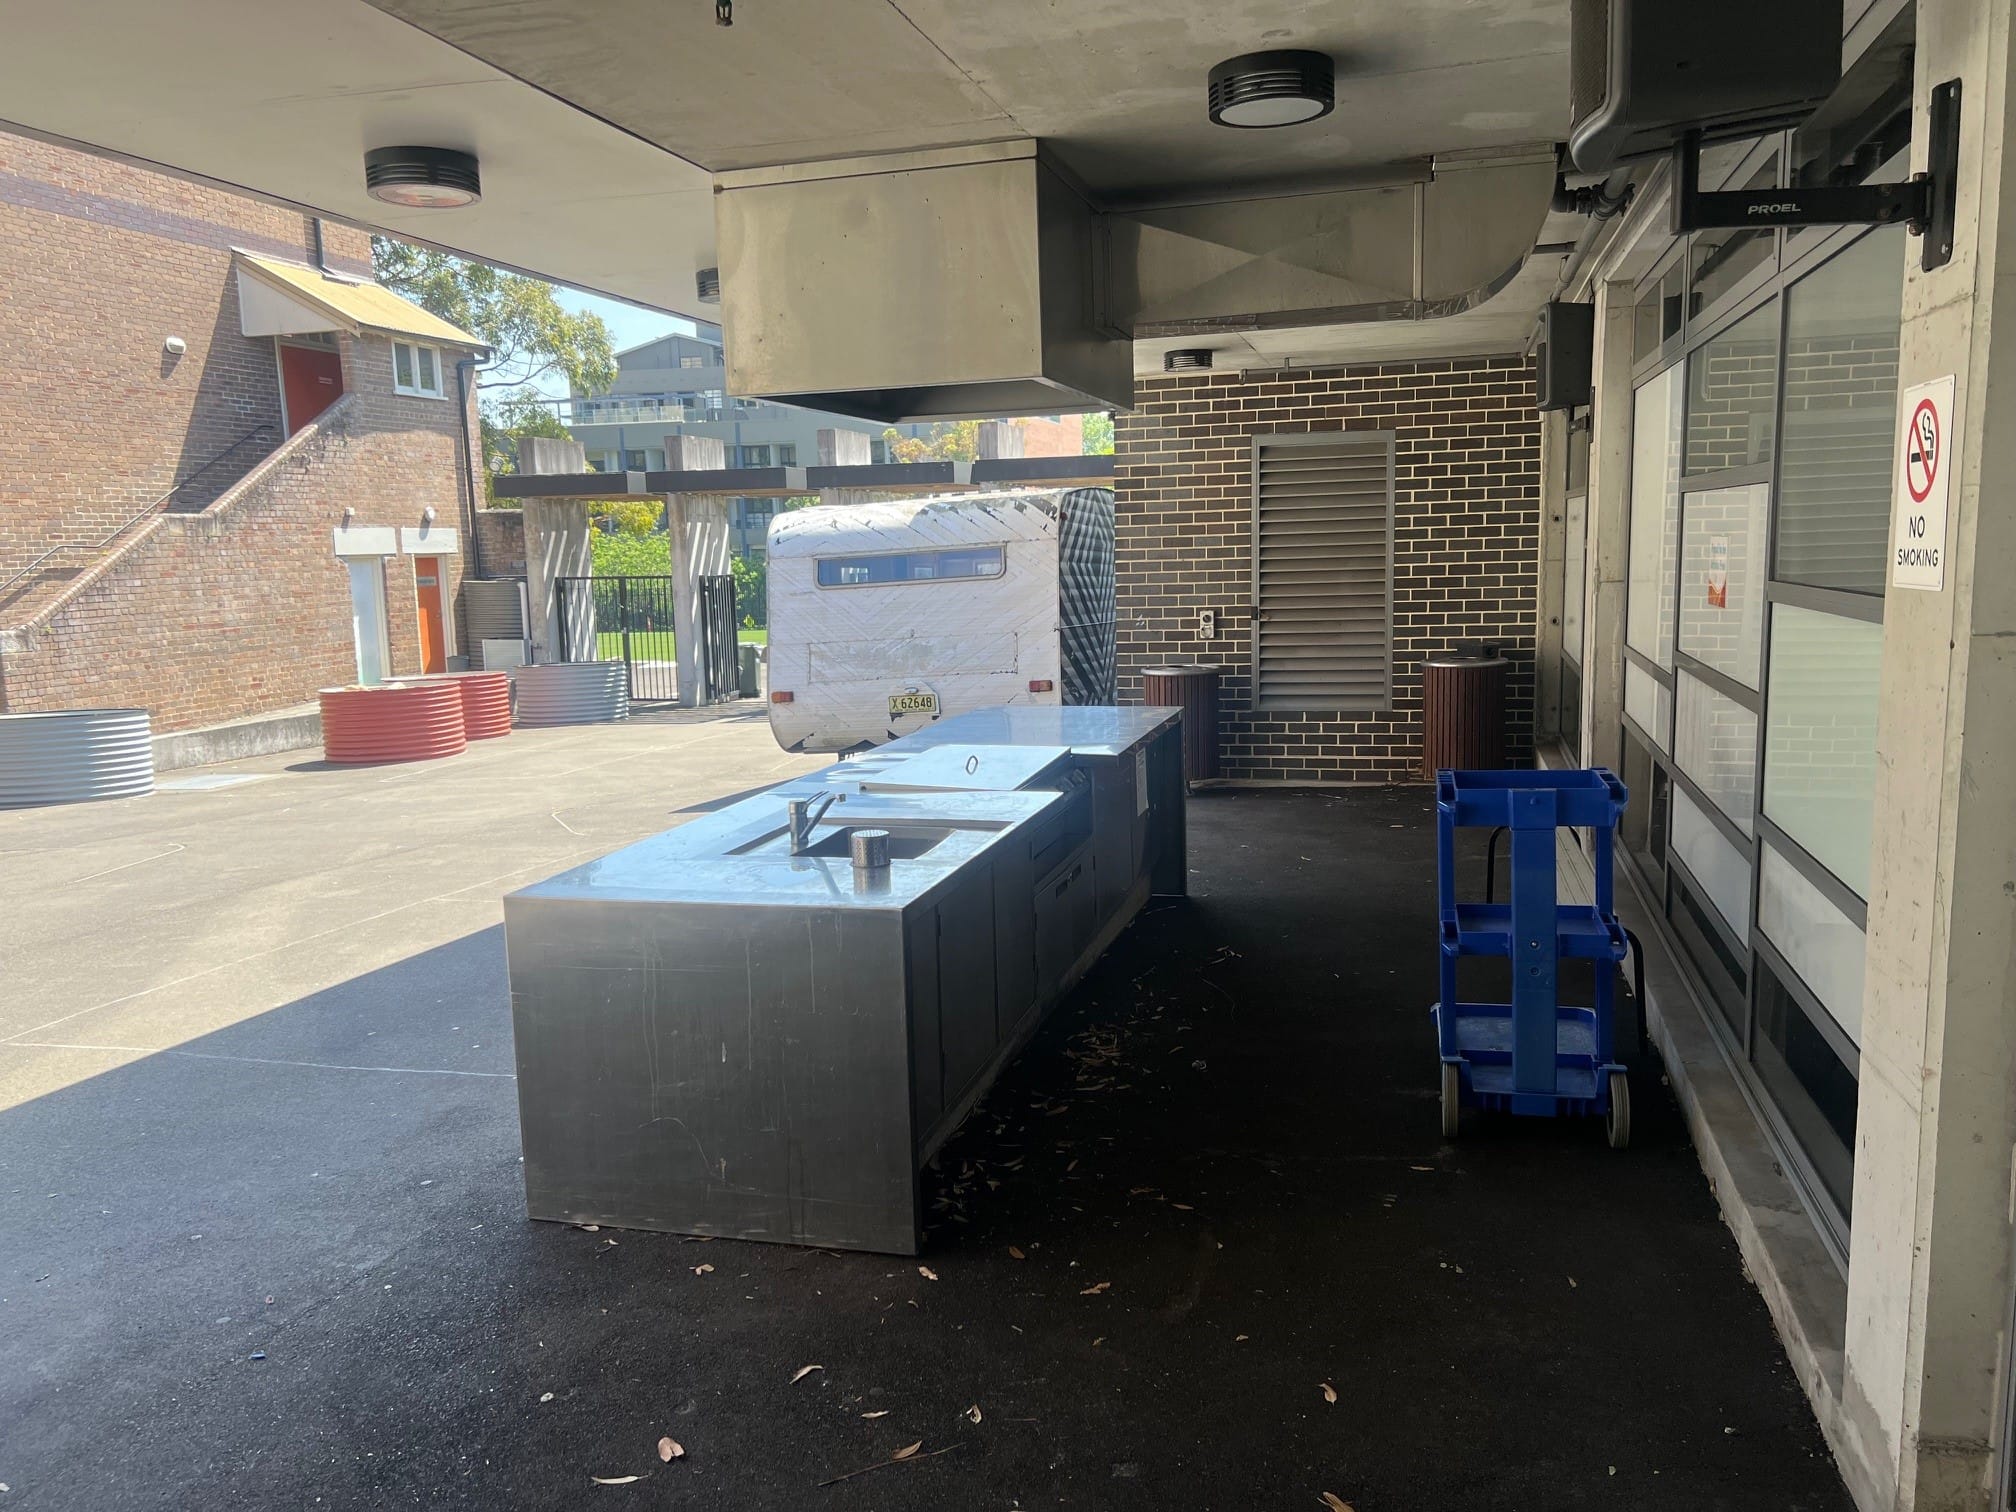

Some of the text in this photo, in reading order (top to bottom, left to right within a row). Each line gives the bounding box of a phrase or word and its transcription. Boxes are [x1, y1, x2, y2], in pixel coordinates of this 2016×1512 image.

[1747, 203, 1801, 215] PROEL
[1909, 515, 1925, 538] NO
[1897, 548, 1939, 567] SMOKING
[892, 698, 898, 709] X
